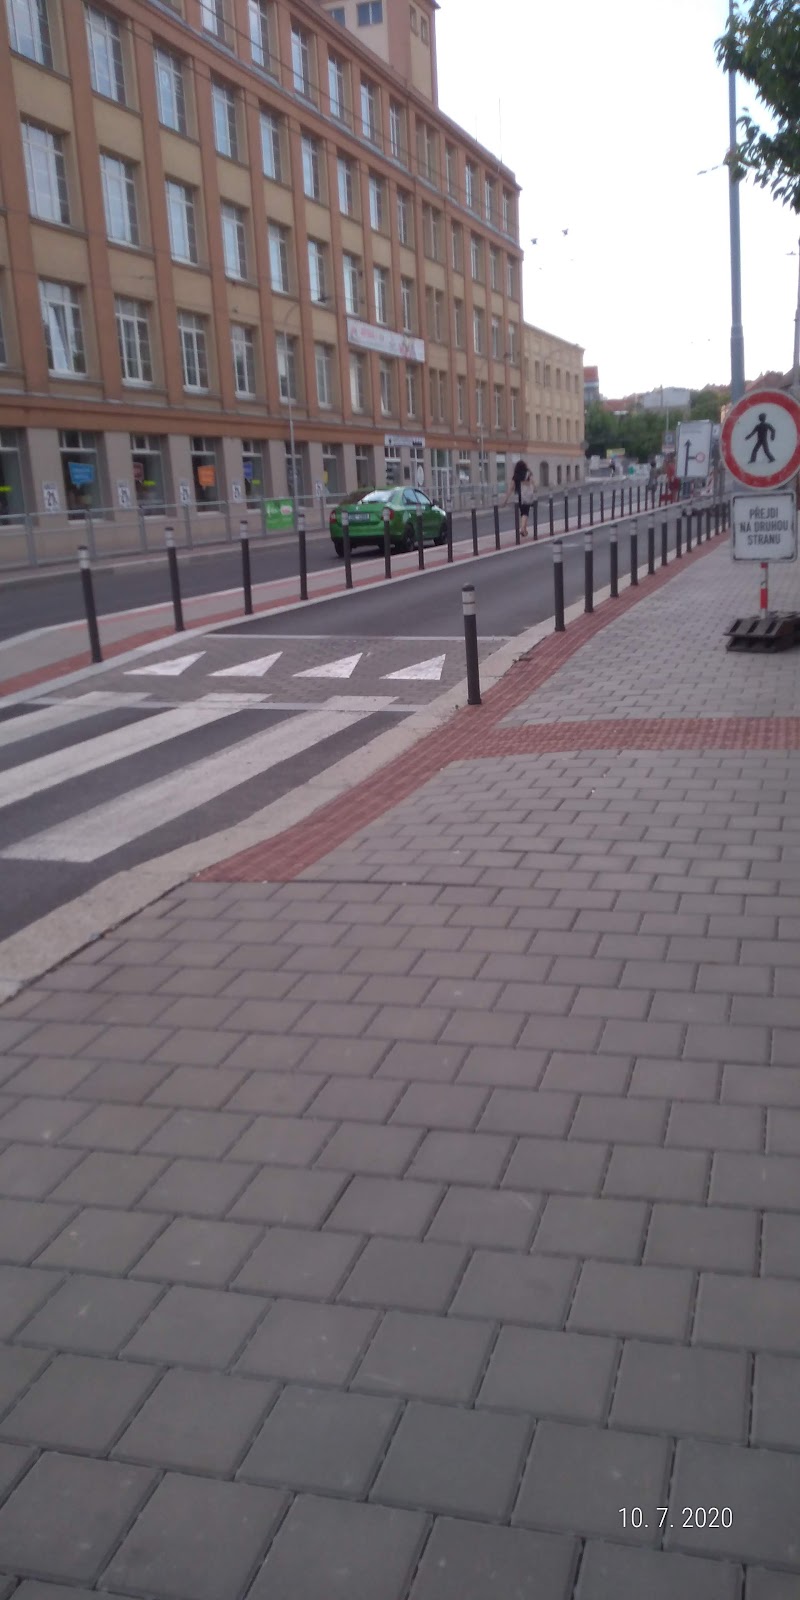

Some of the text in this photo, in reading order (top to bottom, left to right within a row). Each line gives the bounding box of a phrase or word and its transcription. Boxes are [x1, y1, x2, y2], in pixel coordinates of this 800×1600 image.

[749, 506, 779, 520] PŘEJDI
[740, 520, 788, 533] NA DRUHOU
[747, 534, 781, 546] STRANU
